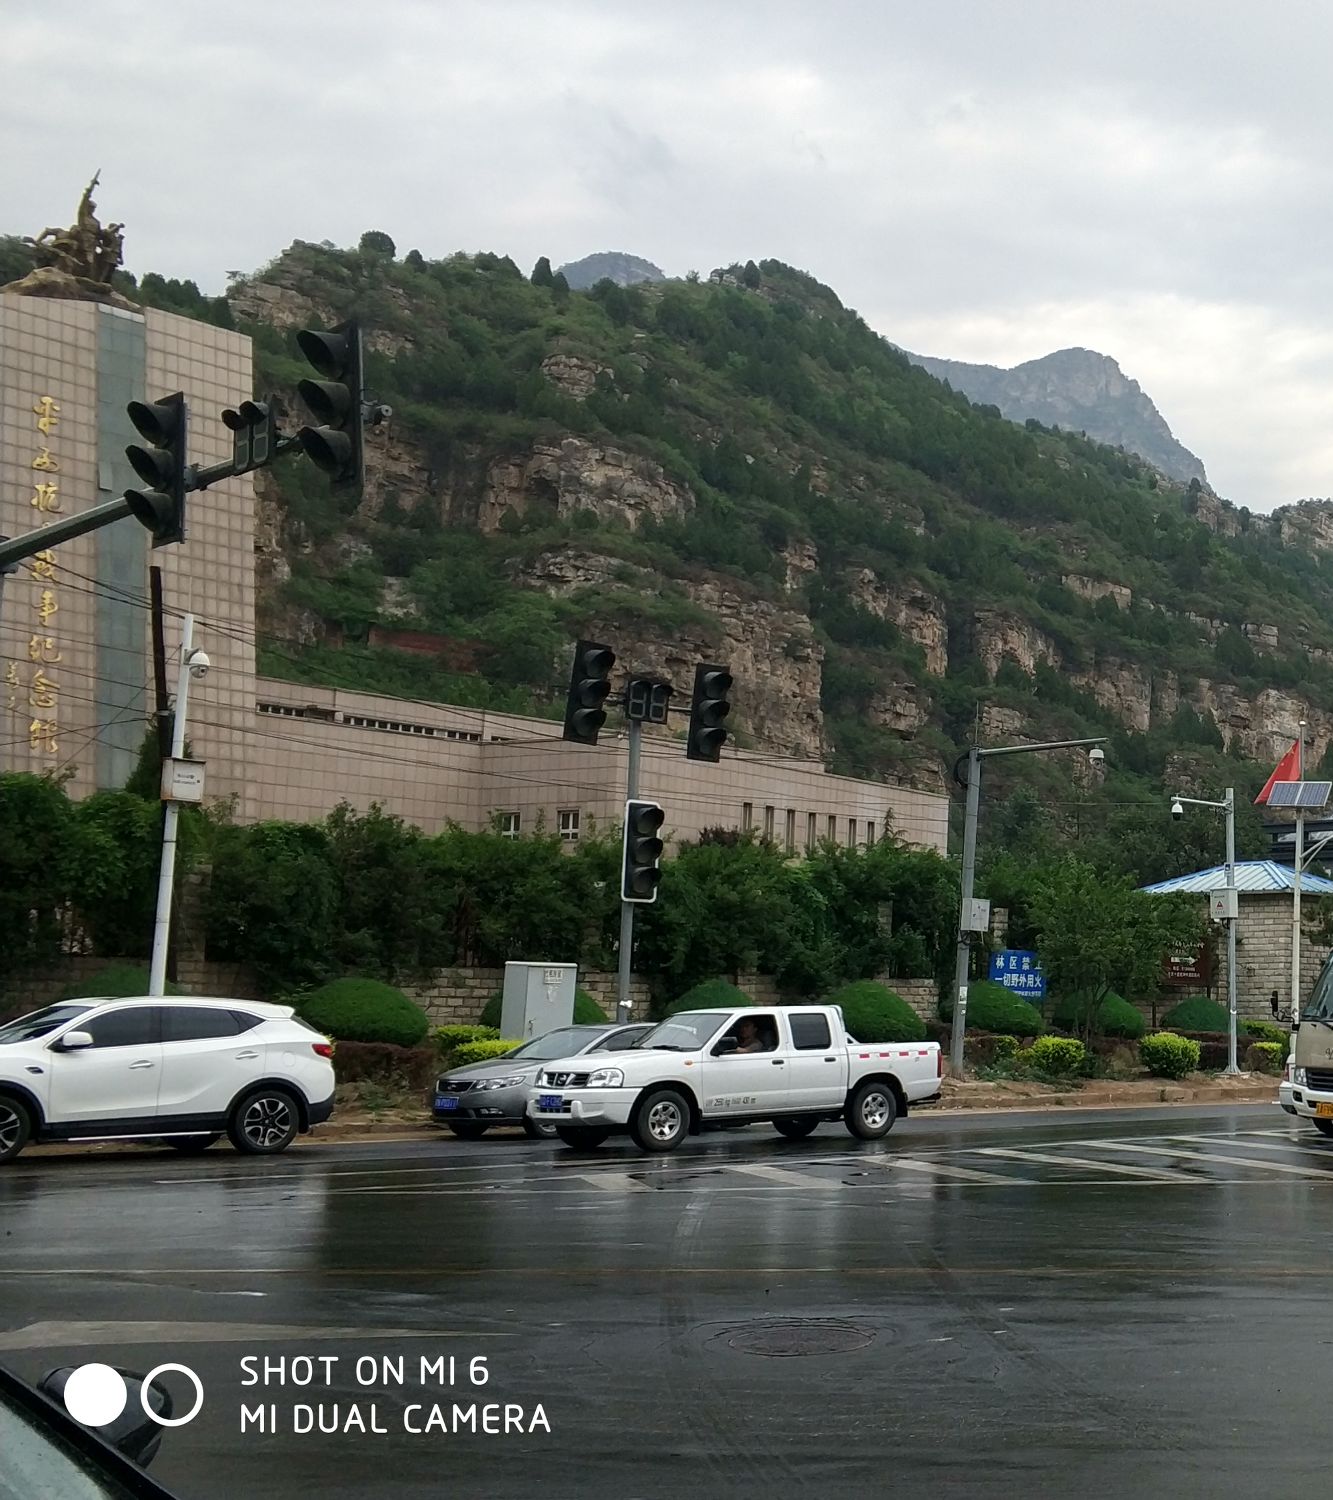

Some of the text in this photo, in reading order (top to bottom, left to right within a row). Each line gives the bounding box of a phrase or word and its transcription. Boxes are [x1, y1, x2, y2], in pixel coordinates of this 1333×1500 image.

[994, 973, 1042, 988] 一切野外用火
